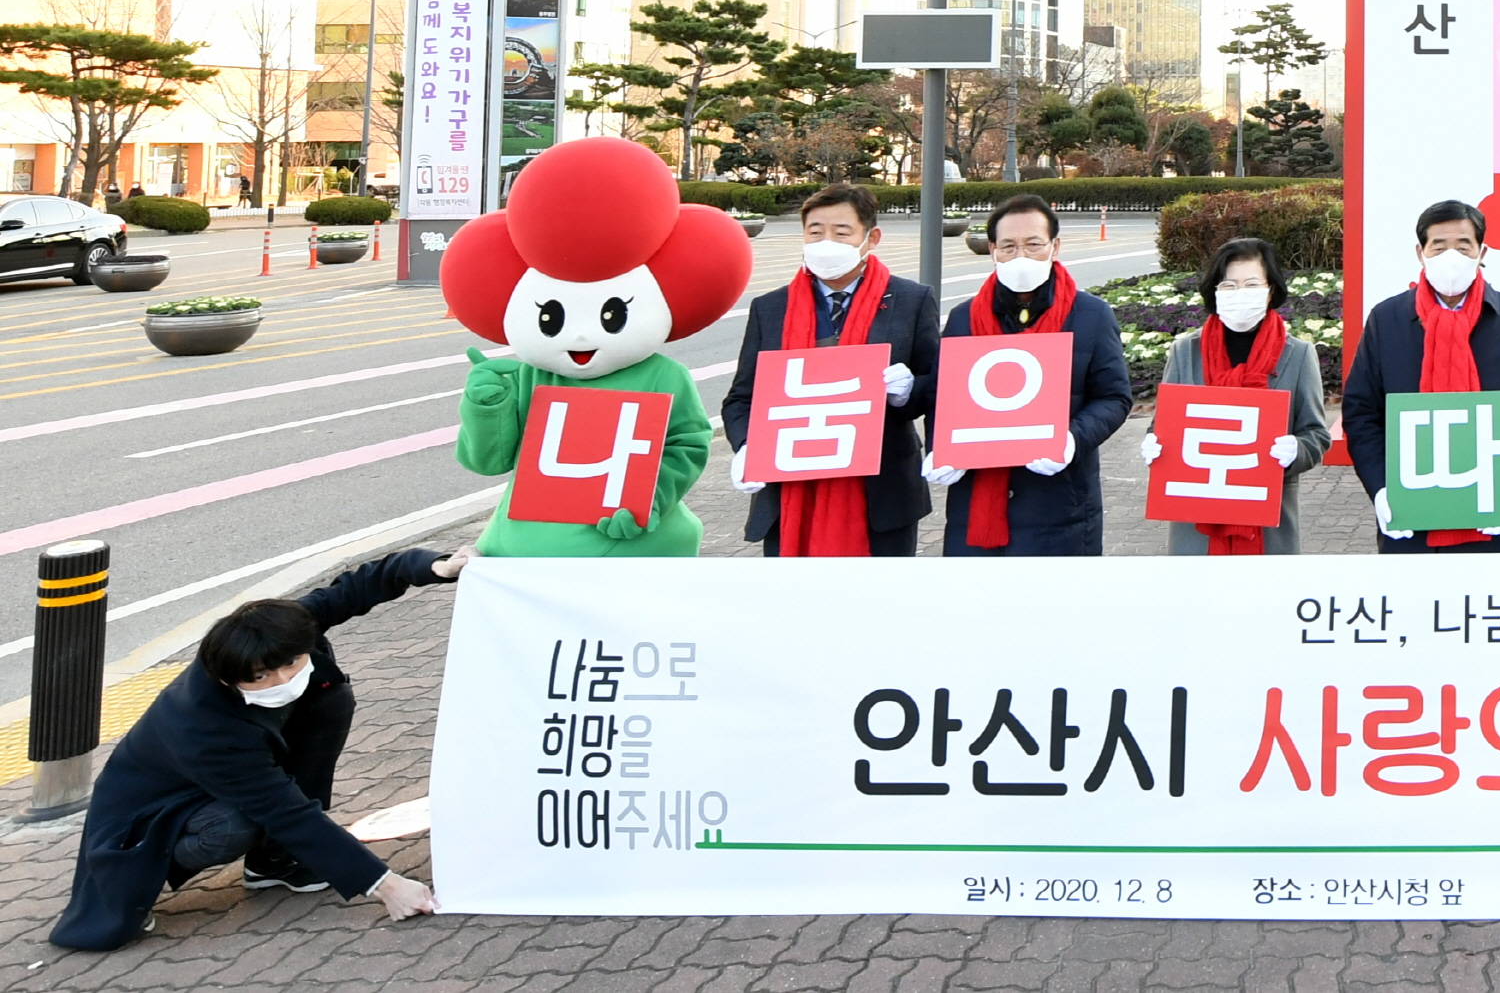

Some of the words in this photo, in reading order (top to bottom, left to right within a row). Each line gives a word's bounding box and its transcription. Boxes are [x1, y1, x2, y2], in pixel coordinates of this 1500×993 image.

[420, 37, 440, 124] 도와요!
[438, 177, 470, 193] 129
[768, 357, 872, 472] 눔
[951, 348, 1054, 444] 으
[538, 401, 652, 508] 나
[1165, 403, 1269, 500] 로
[1296, 595, 1408, 647] 안산,
[547, 639, 698, 703] 나눔으로
[537, 712, 653, 778] 희망을
[853, 686, 1188, 798] 안산시
[537, 789, 729, 851] 이어주세요
[1156, 879, 1173, 903] 8
[1323, 878, 1429, 906] 안산시청
[1438, 878, 1465, 906] 앞
